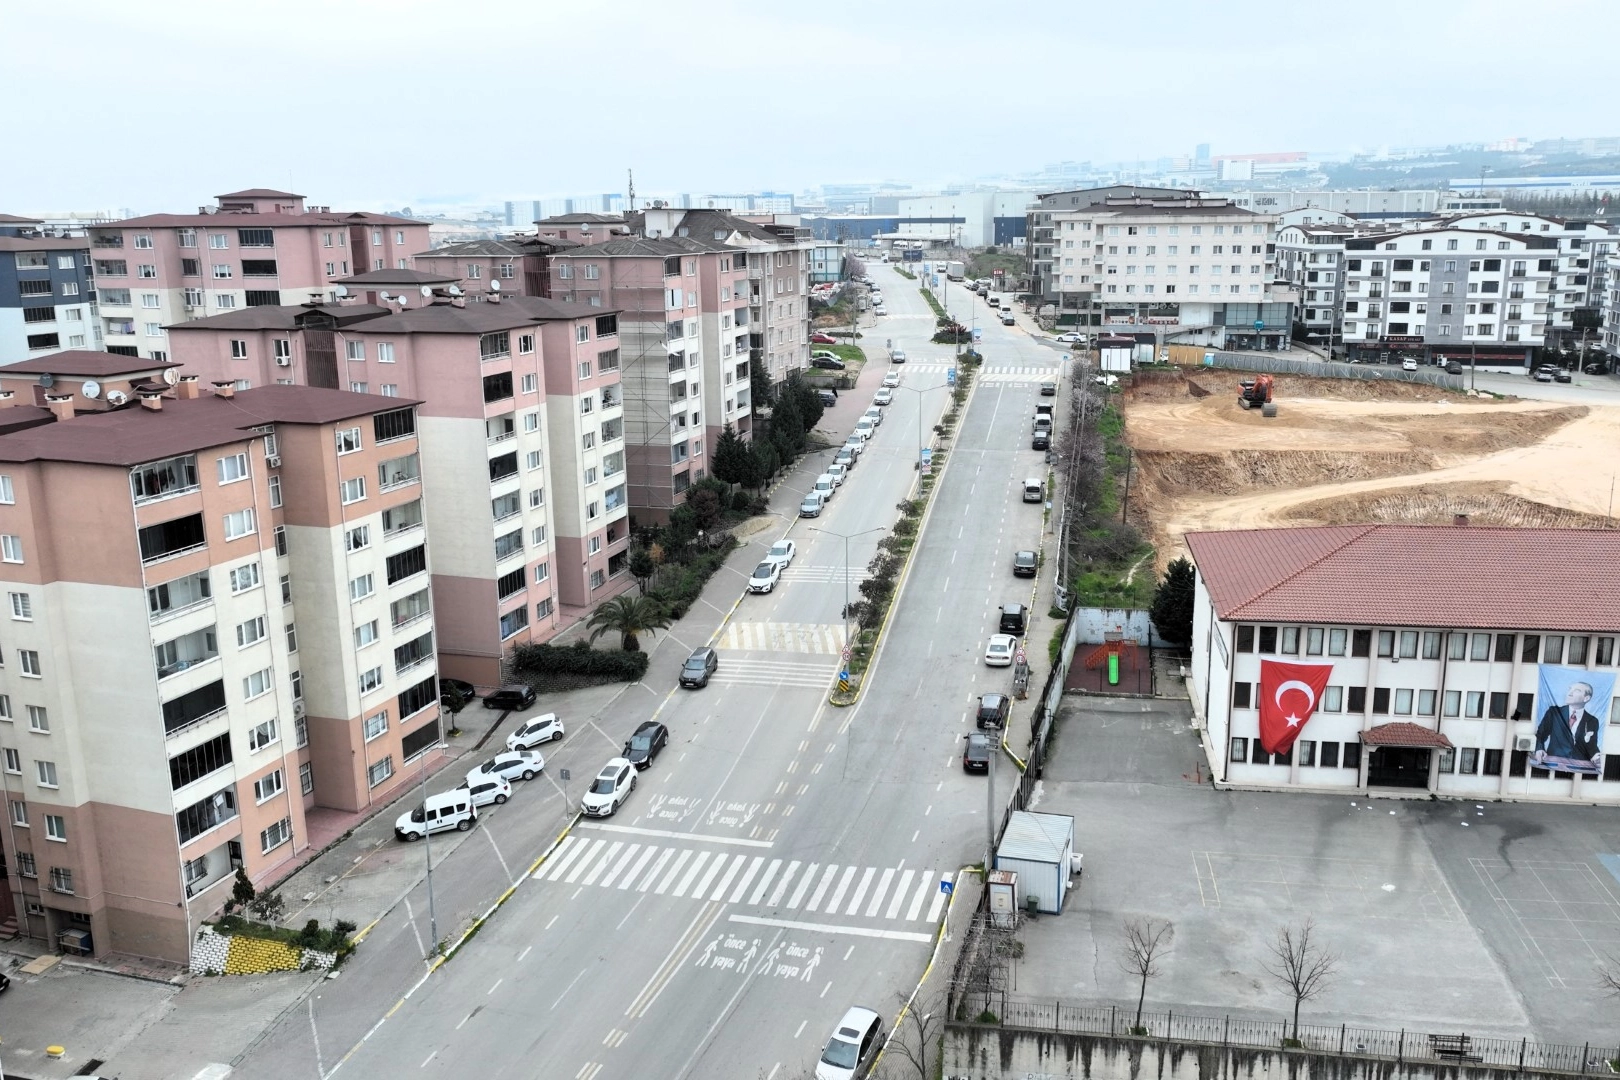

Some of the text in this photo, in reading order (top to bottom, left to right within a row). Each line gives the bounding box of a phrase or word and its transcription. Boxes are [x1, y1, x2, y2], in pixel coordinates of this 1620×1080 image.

[724, 934, 747, 950] önce
[786, 942, 809, 958] önce
[710, 956, 736, 970] yaya
[774, 964, 800, 979] yaya
